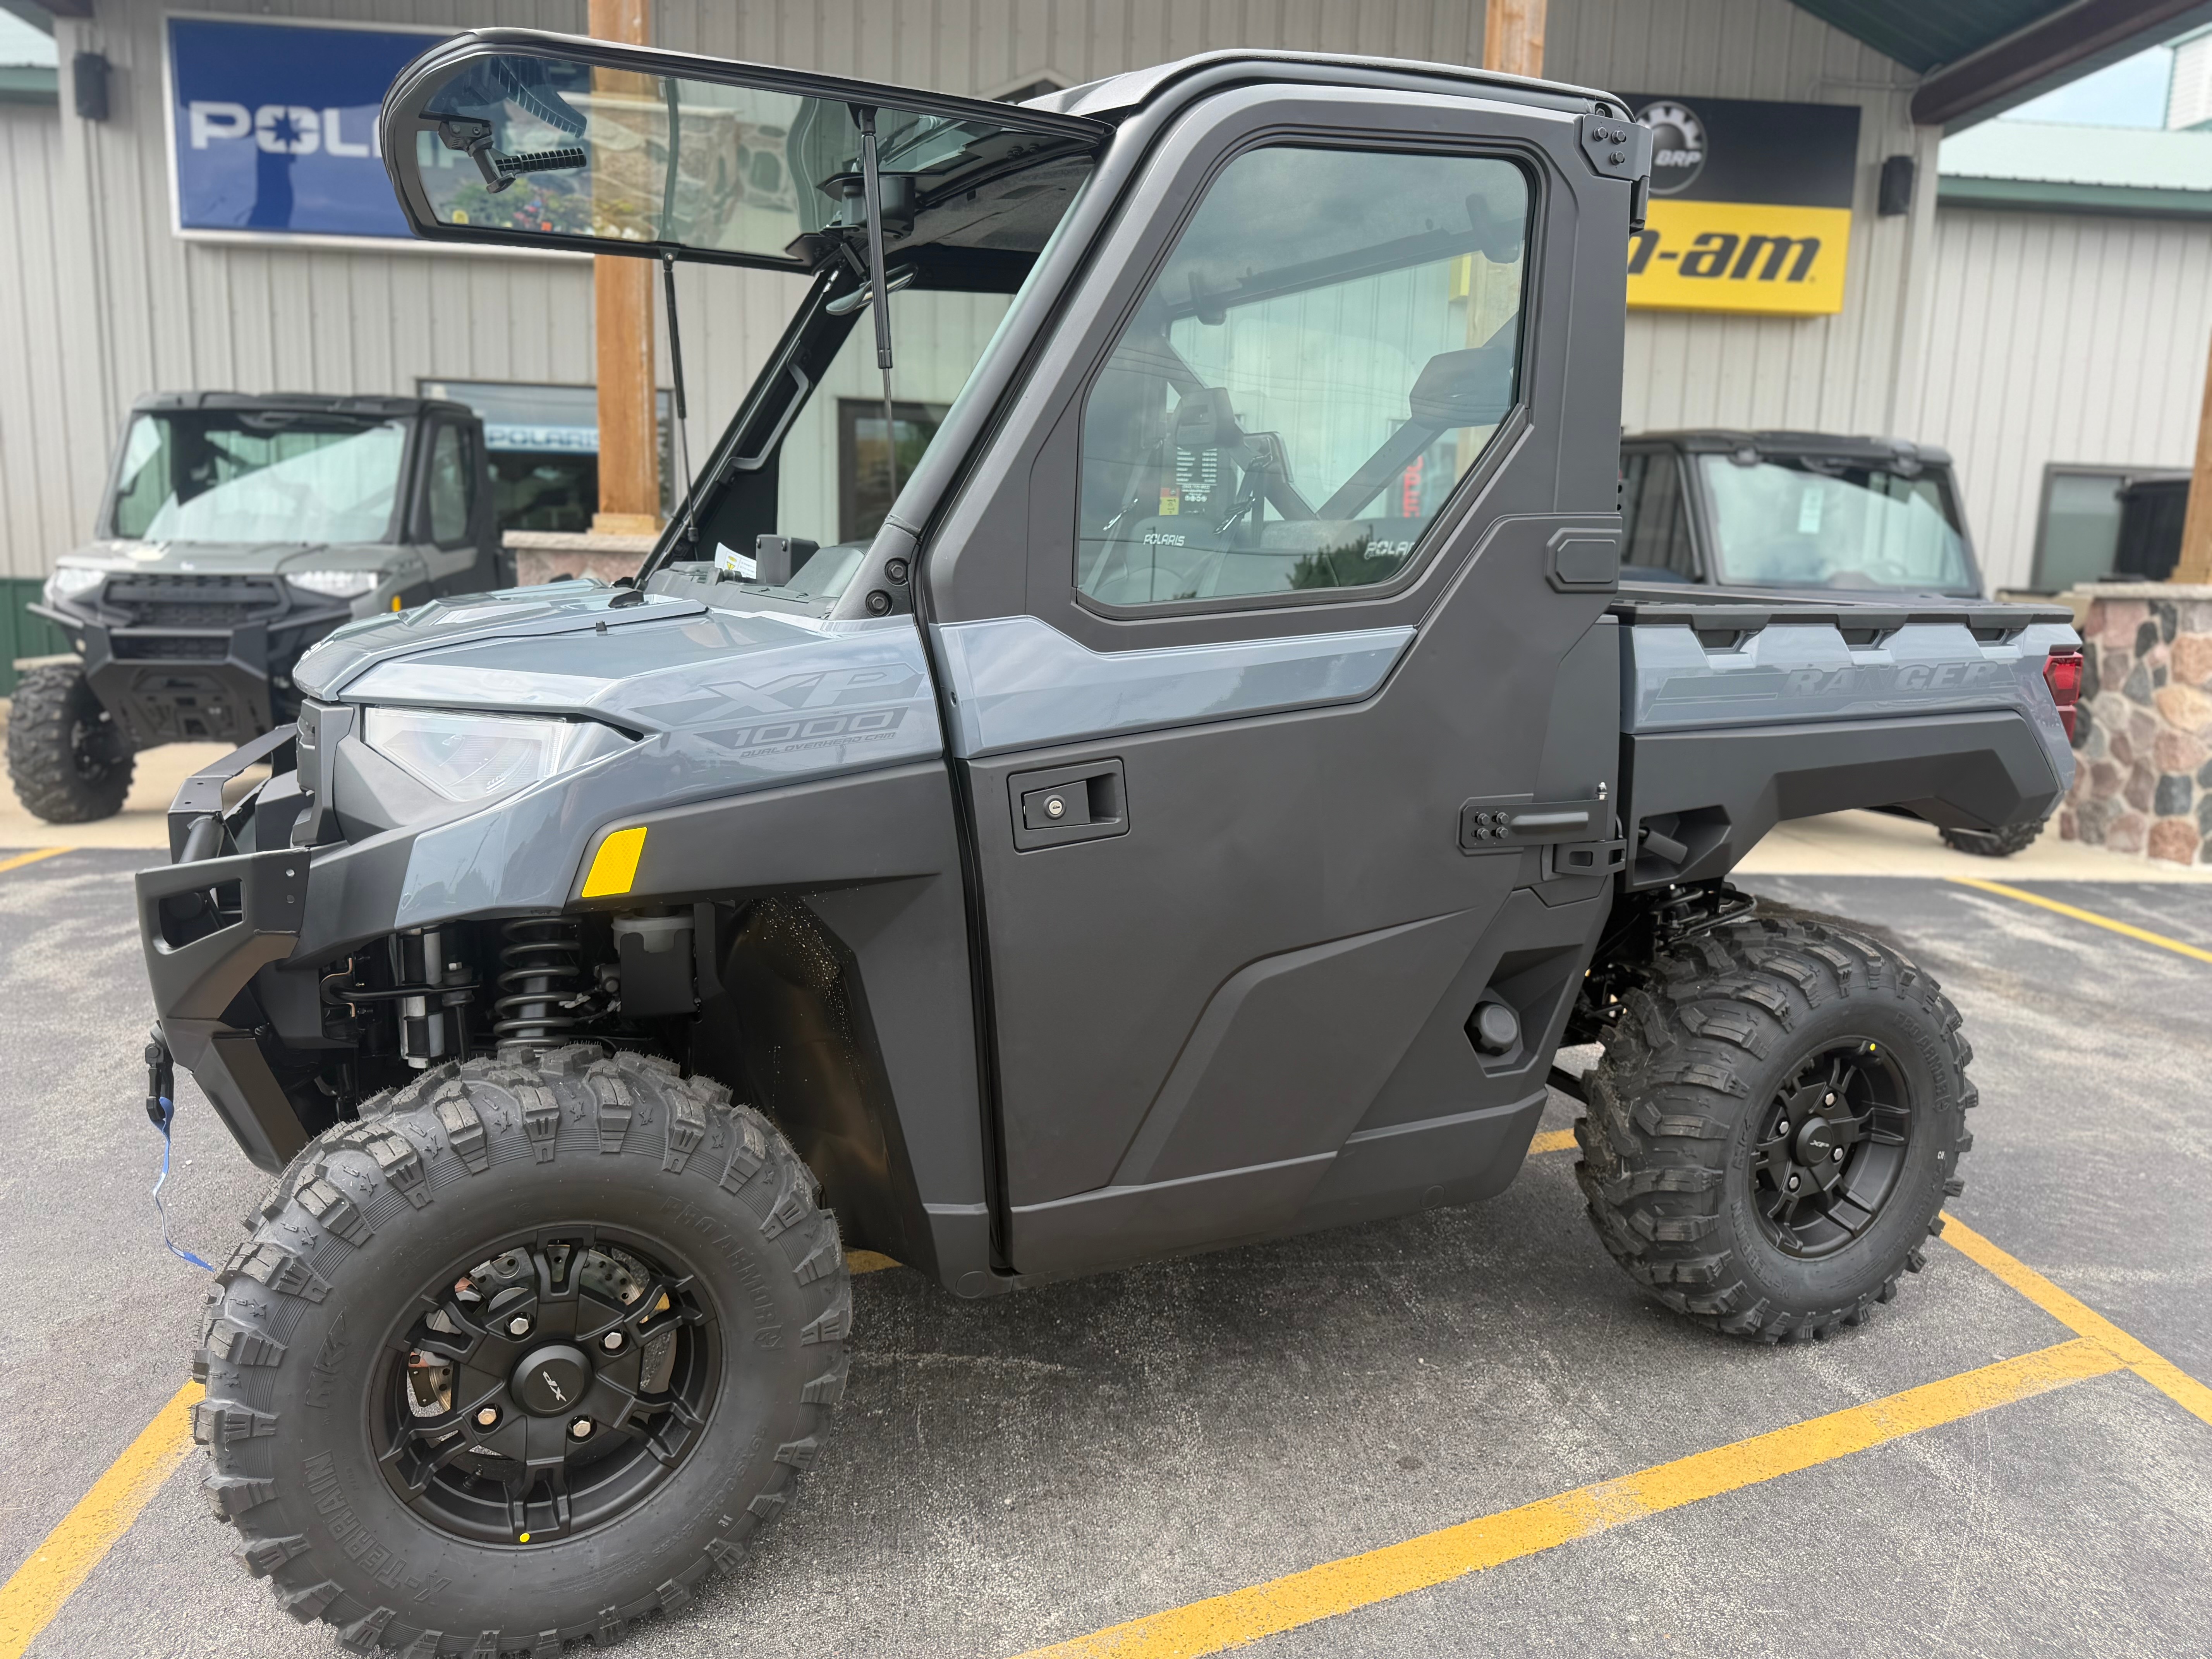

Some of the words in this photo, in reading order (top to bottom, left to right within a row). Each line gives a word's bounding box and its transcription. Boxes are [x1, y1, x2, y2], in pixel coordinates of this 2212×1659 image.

[190, 101, 381, 157] POL
[1655, 150, 1701, 167] BRP
[1143, 534, 1185, 546] POLARIS
[685, 663, 916, 722] XP
[1779, 661, 1999, 696] RANGER
[735, 710, 894, 747] 1000
[740, 747, 780, 758] DUAL
[785, 737, 861, 752] OVERHEAD
[864, 732, 896, 741] CAM
[659, 1196, 719, 1239] PRO
[713, 1235, 776, 1324] ARMOR
[1731, 1197, 1793, 1298] X-TERRAIN
[543, 1371, 567, 1402] XP
[303, 1450, 452, 1606] X-TERRAIN
